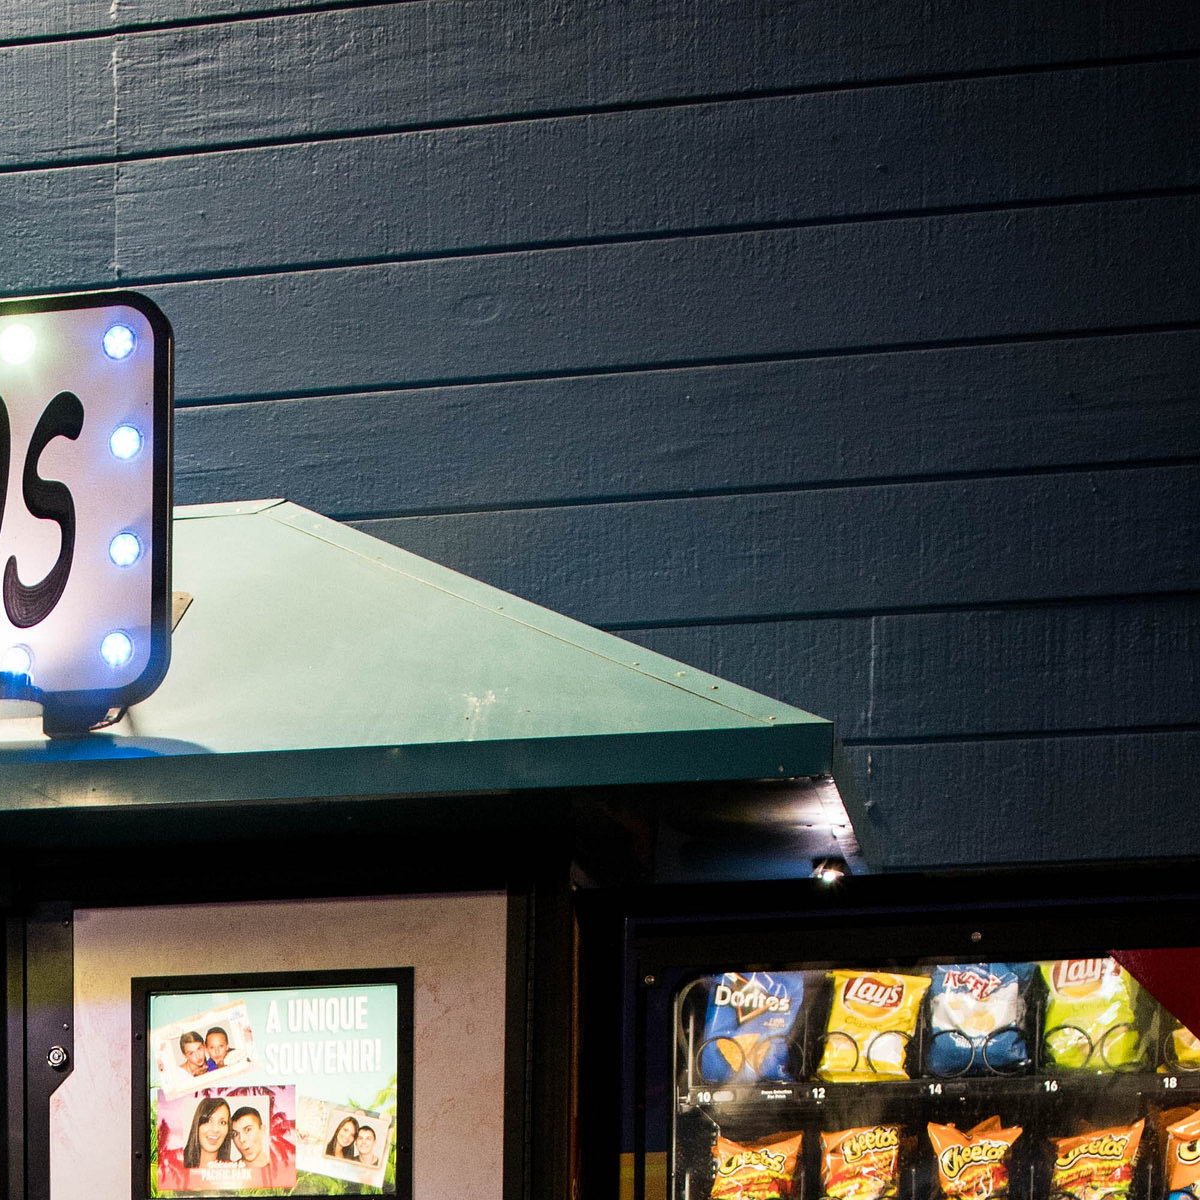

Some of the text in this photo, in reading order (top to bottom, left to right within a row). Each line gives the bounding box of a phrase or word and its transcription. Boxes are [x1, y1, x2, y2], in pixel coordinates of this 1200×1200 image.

[715, 985, 791, 1013] Doritos
[847, 977, 904, 1010] Lay's
[266, 996, 369, 1033] A UNIQUE
[265, 1038, 382, 1076] SOUVENIR!
[697, 1092, 711, 1102] 10
[812, 1088, 825, 1099] 12
[928, 1083, 942, 1095] 14
[1044, 1080, 1058, 1093] 16
[1163, 1077, 1178, 1089] 18
[841, 1125, 899, 1164] Cheetos
[939, 1140, 1011, 1180] Cheetos
